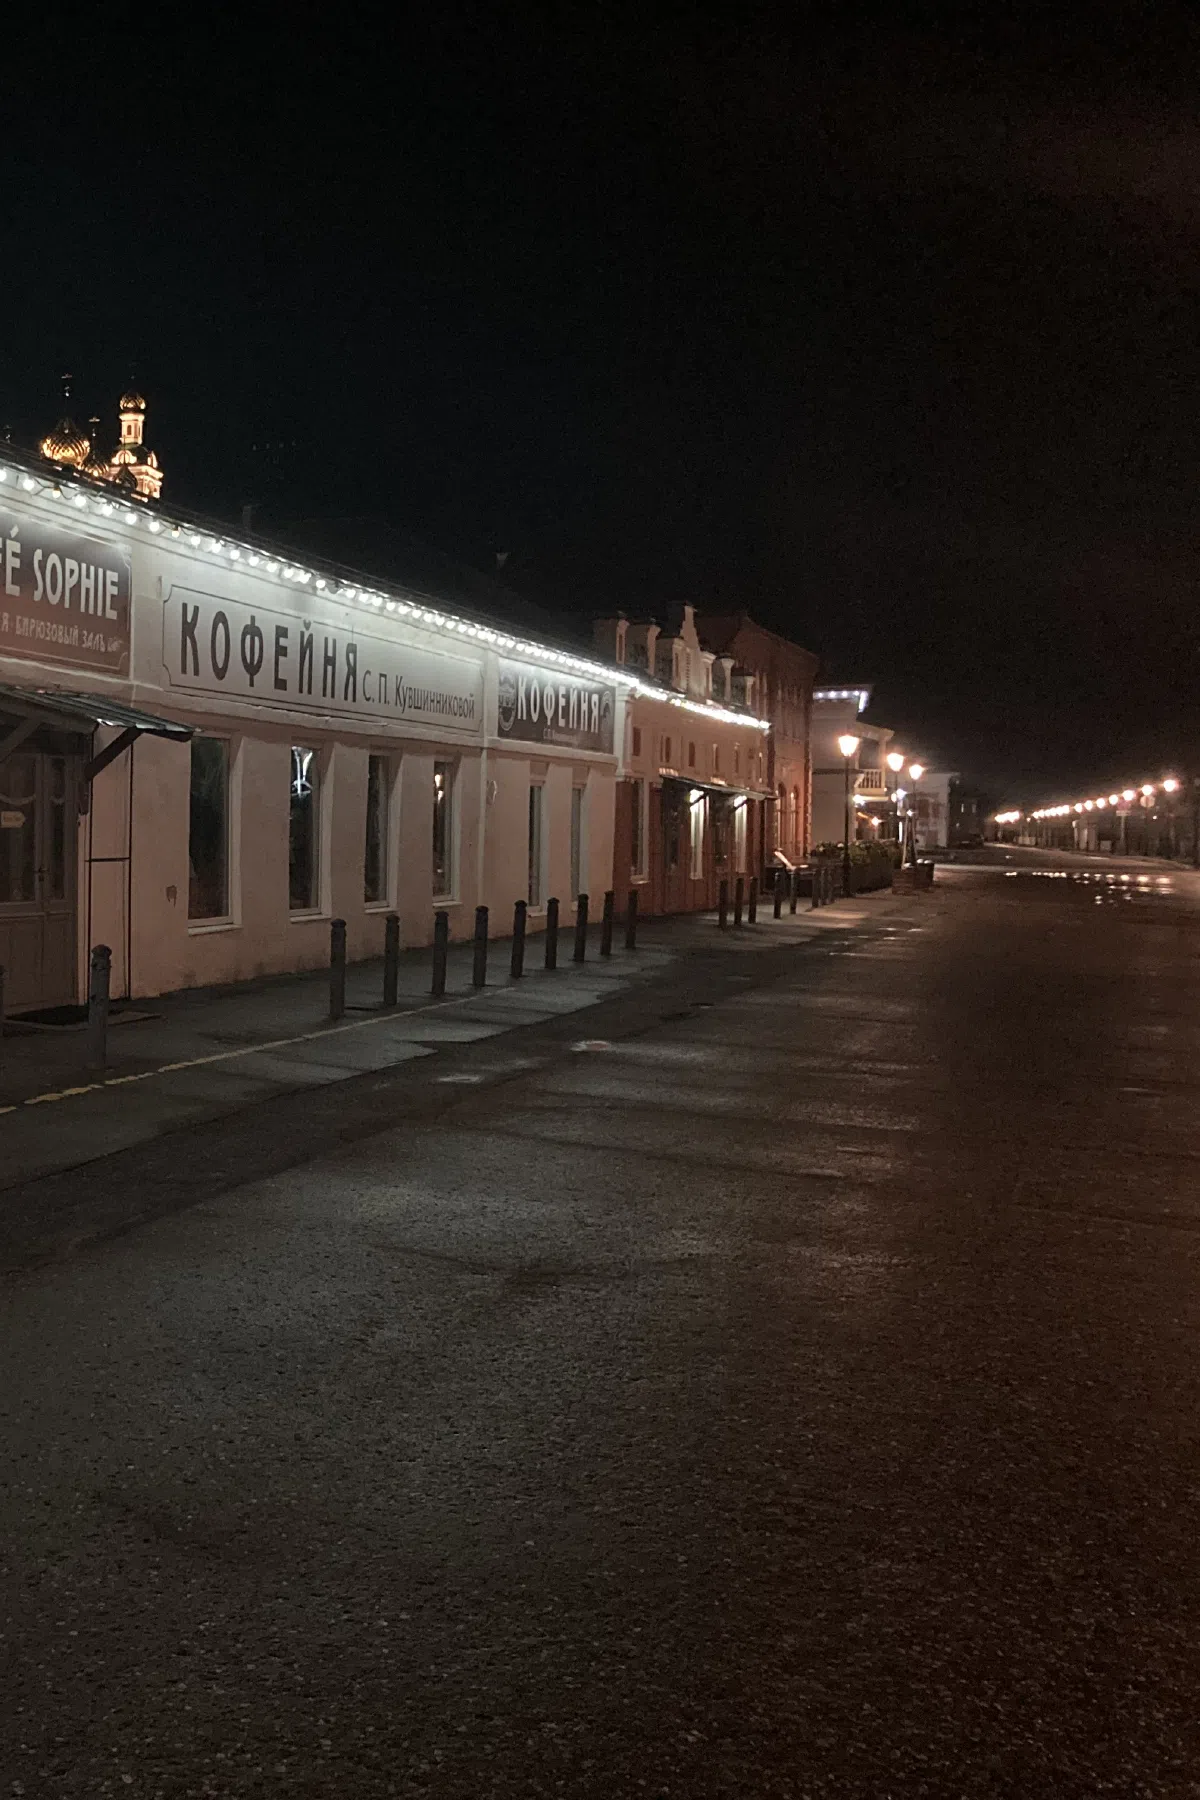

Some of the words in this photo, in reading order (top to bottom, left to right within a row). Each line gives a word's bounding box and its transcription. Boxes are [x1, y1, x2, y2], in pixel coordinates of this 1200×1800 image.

[33, 549, 119, 620] SOPHIE
[181, 602, 357, 702] КОФЕЙНЯ
[395, 675, 475, 720] Кувшинниковой
[517, 675, 599, 734] КОФЕЙНЯ
